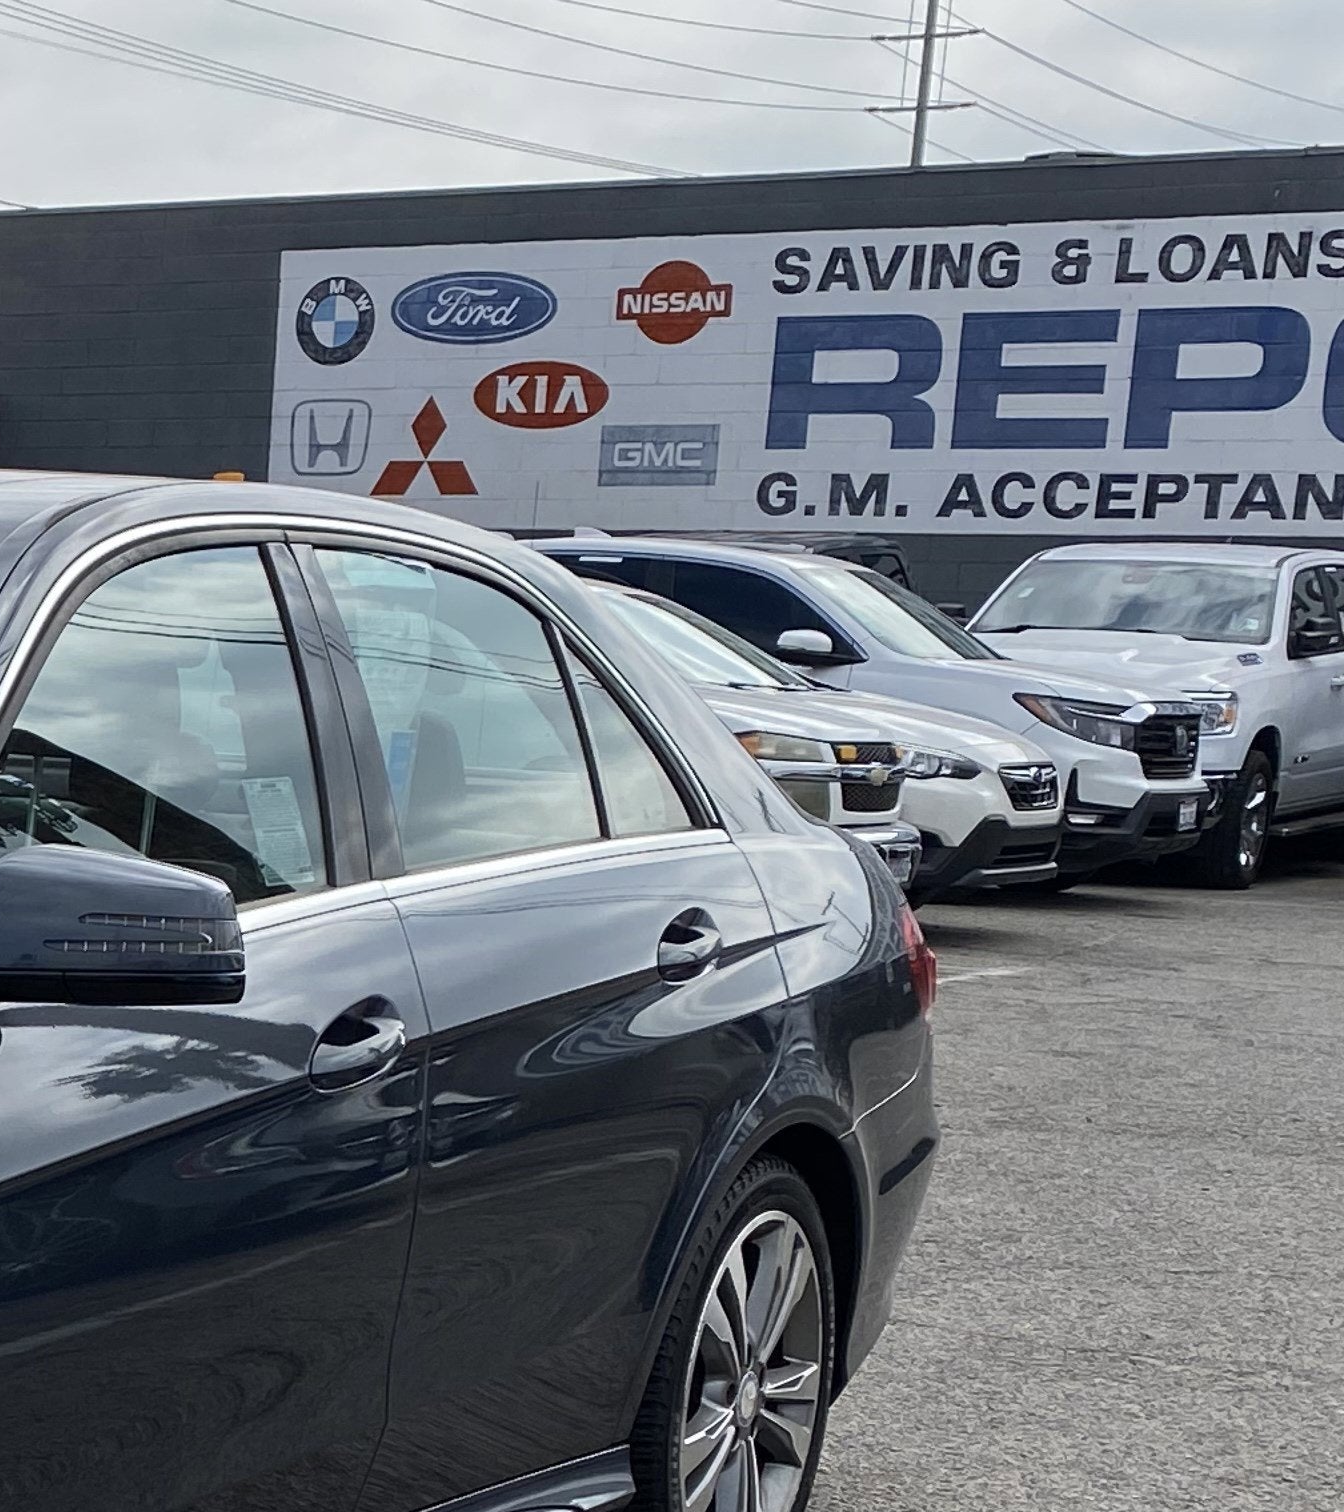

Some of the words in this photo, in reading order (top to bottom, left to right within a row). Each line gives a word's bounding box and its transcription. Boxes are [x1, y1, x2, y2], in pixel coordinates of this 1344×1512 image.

[772, 240, 1022, 294] SAVING
[1050, 239, 1092, 285] &
[1115, 231, 1344, 284] LOANS
[427, 285, 521, 326] Ford
[622, 290, 726, 315] NISSAN
[495, 374, 589, 414] KIA
[765, 306, 1344, 449] REP
[613, 441, 705, 467] GMC
[756, 472, 909, 517] G.M.
[935, 471, 1344, 520] ACCEPTAN
